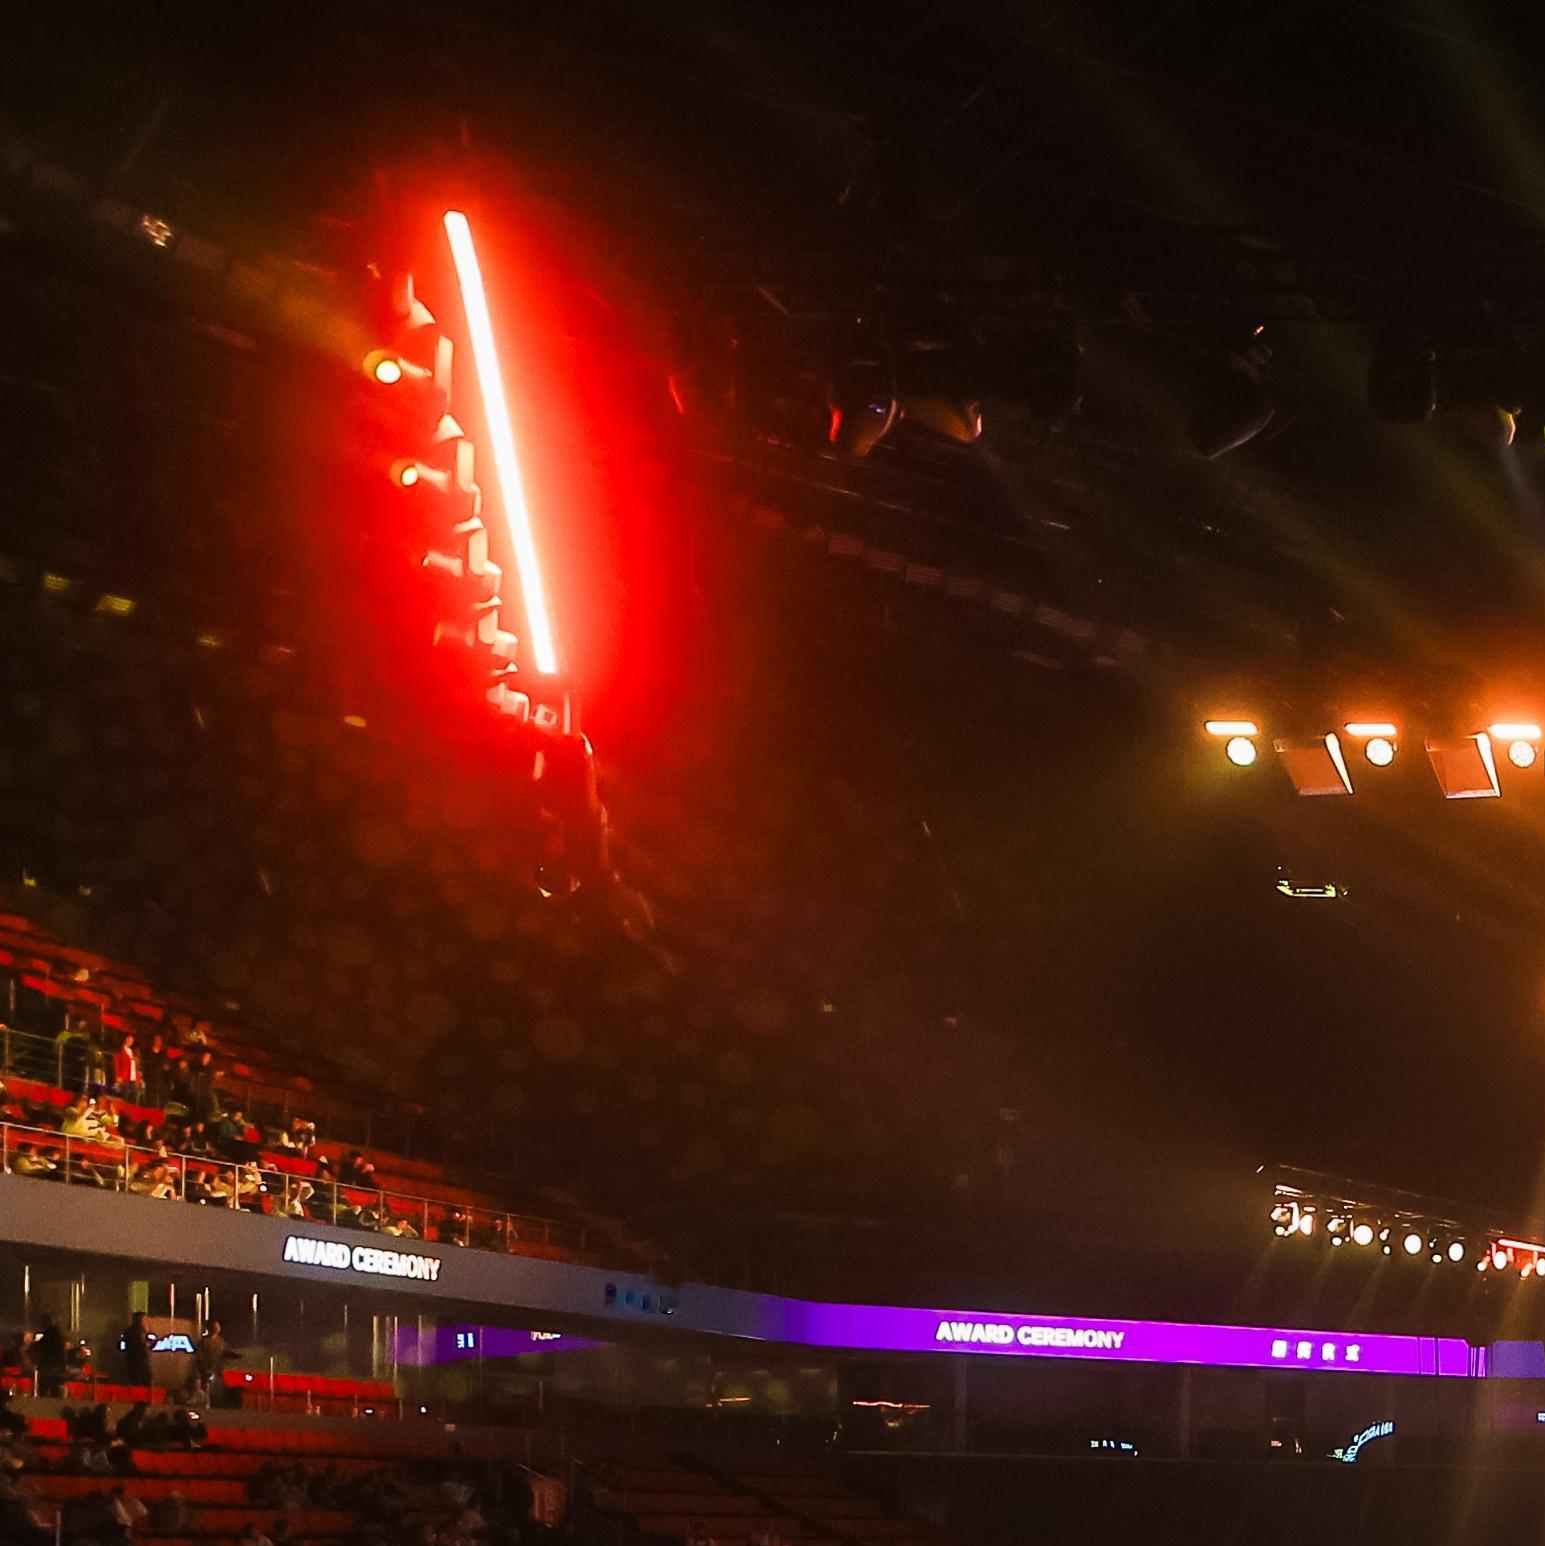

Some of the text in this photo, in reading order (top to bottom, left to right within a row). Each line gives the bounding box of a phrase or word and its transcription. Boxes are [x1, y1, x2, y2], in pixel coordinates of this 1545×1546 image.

[284, 1236, 441, 1281] AWARD CEREMONY
[936, 1321, 1125, 1349] AWARD CEREMONY
